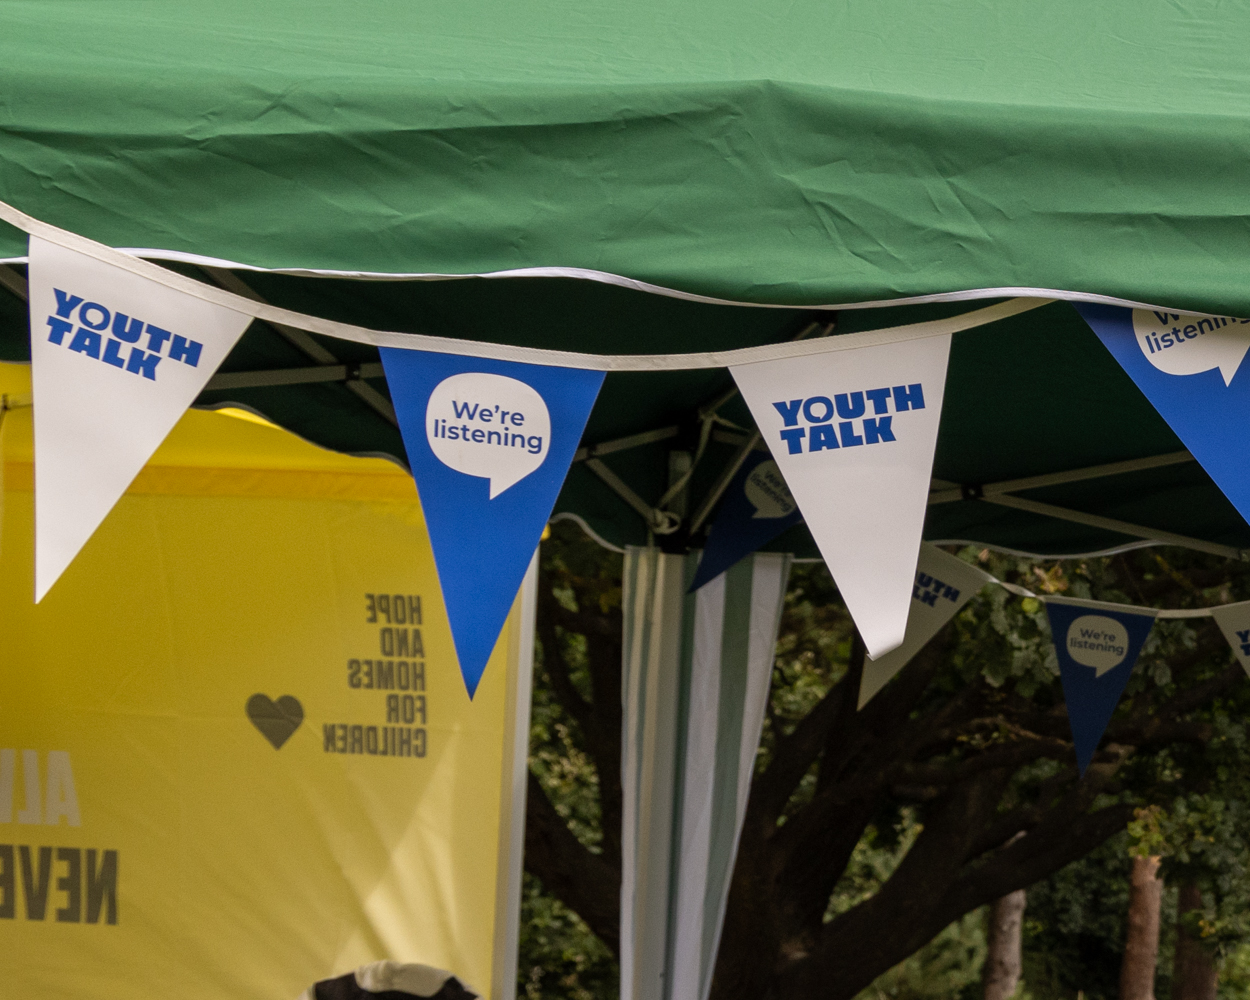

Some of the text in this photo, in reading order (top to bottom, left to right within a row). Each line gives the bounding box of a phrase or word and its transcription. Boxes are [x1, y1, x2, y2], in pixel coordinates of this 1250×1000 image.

[53, 287, 204, 367] YOUTH
[45, 315, 162, 382] TALK
[451, 400, 525, 427] We're
[771, 382, 925, 427] YOUTH
[433, 419, 544, 456] listening
[779, 415, 897, 455] TALK
[917, 572, 960, 603] UTH
[1070, 637, 1124, 656] listening
